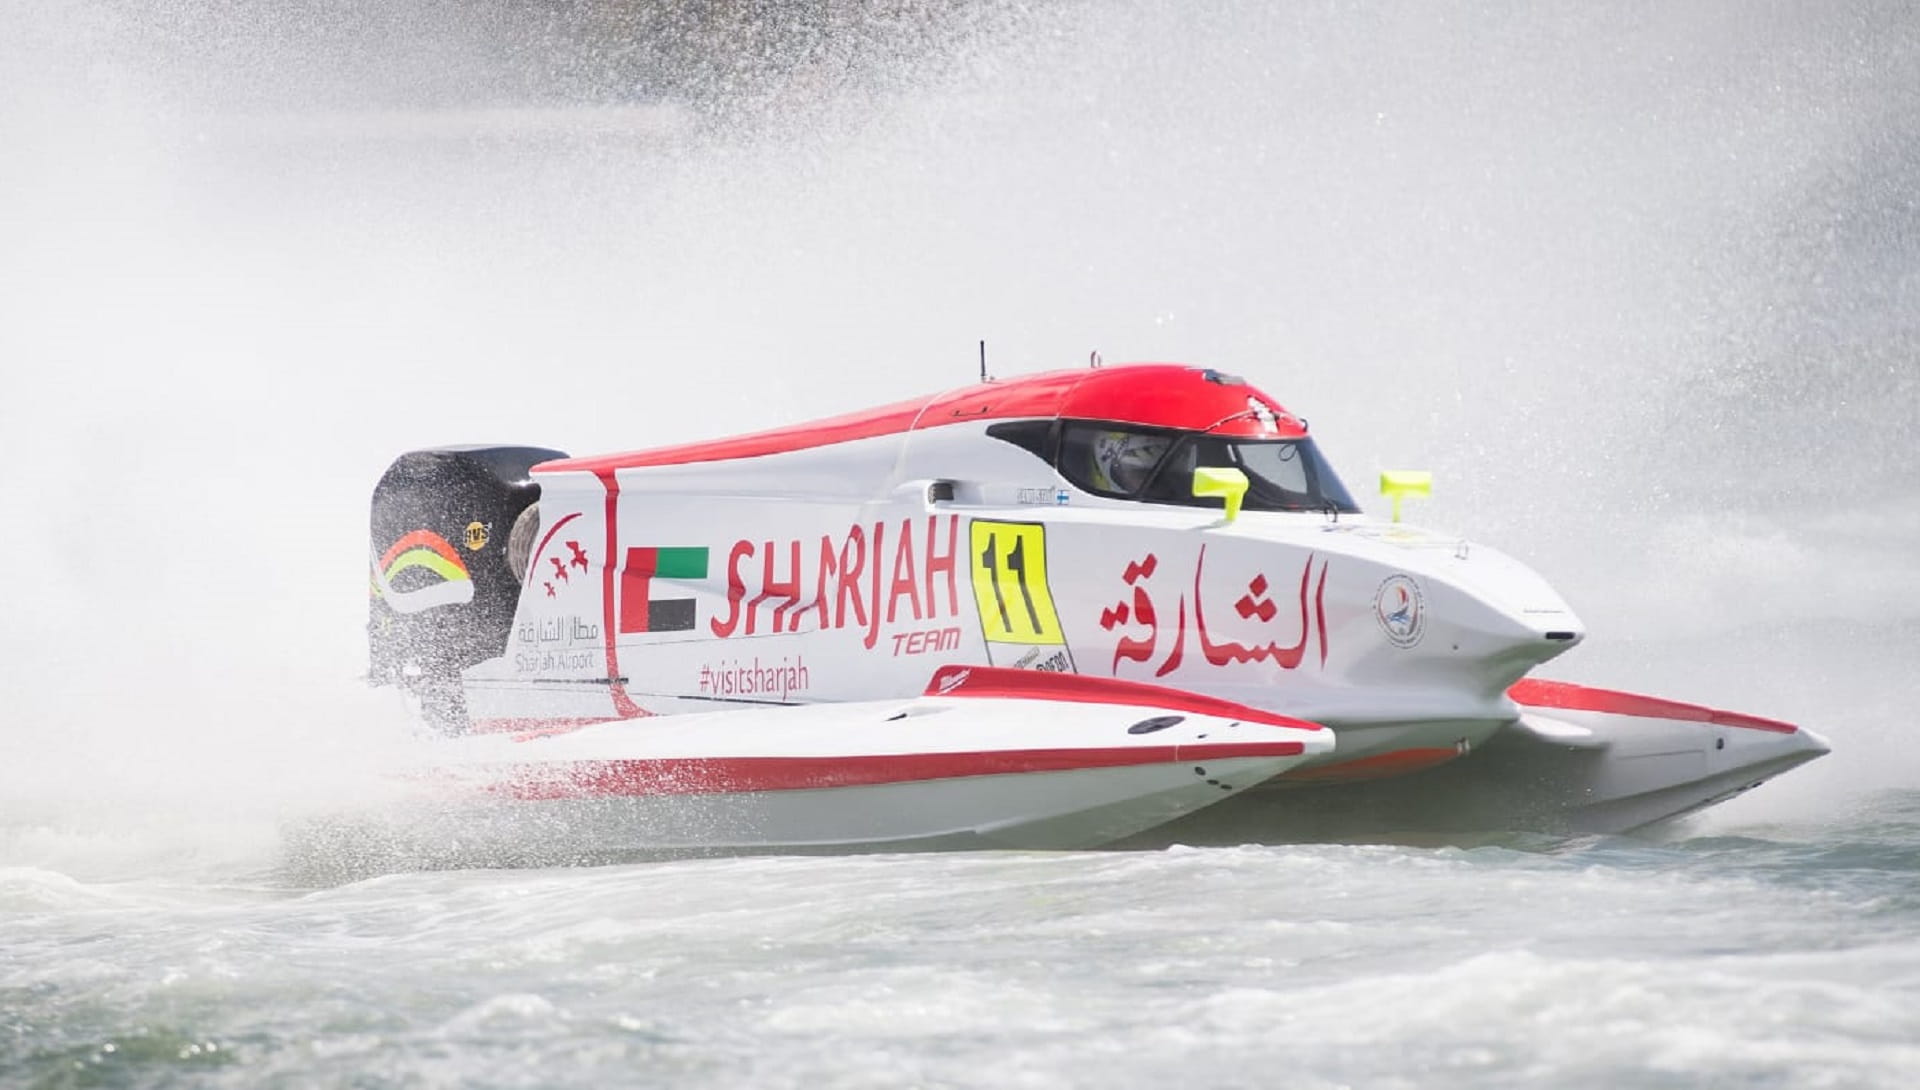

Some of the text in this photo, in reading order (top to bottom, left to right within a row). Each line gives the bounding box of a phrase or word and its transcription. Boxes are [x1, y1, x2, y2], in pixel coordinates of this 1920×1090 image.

[711, 514, 959, 650] SHARJAH
[981, 532, 1044, 635] 11
[1099, 543, 1329, 678] الشارقة
[518, 616, 598, 647] مطار الشارقة
[892, 626, 962, 657] TEAM
[699, 655, 809, 702] #visitsharjah
